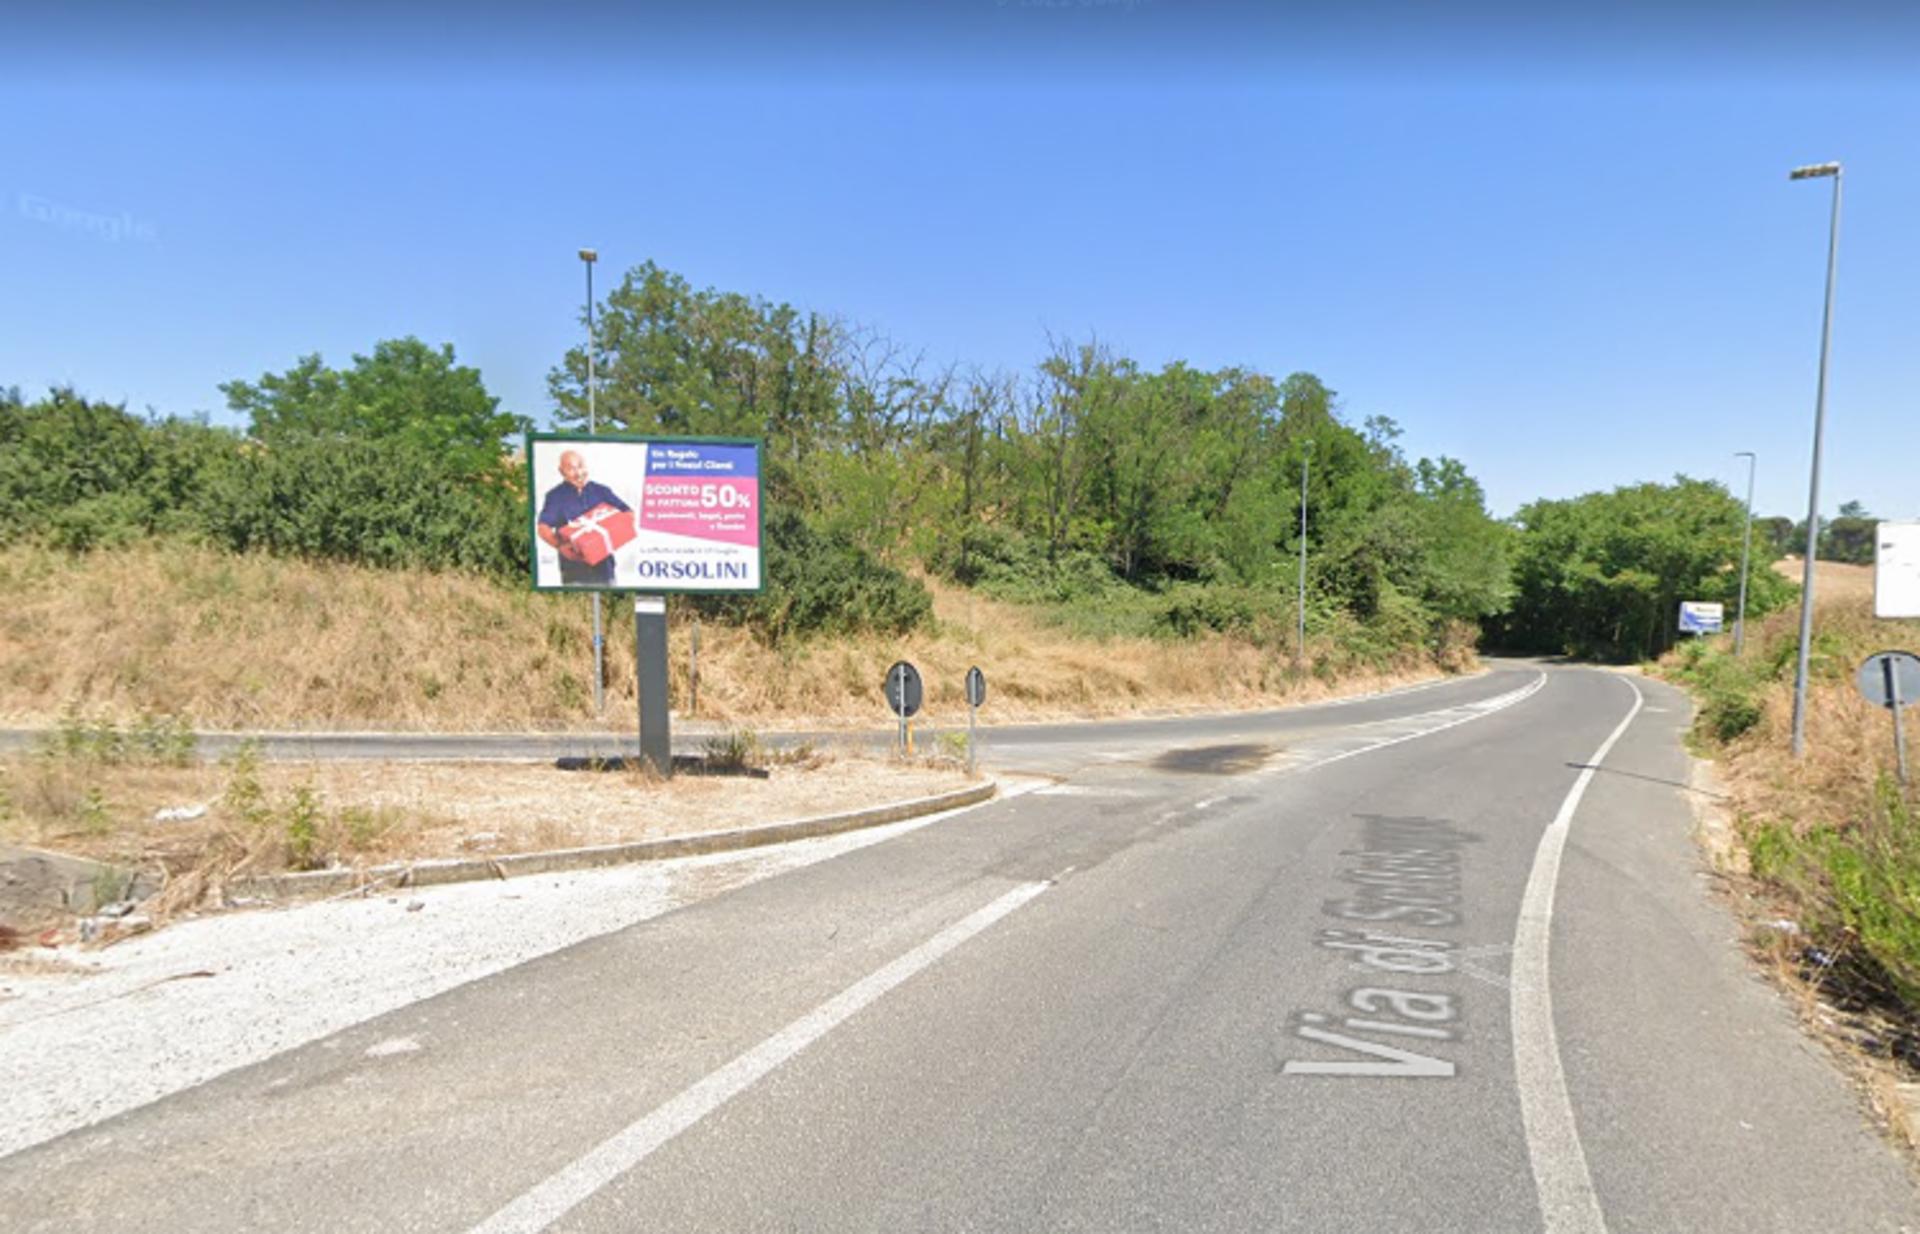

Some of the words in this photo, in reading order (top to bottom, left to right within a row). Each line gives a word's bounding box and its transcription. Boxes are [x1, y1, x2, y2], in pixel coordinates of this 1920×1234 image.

[645, 484, 700, 496] SCONTO
[701, 484, 751, 508] 50%
[639, 560, 747, 579] ORSOLINI
